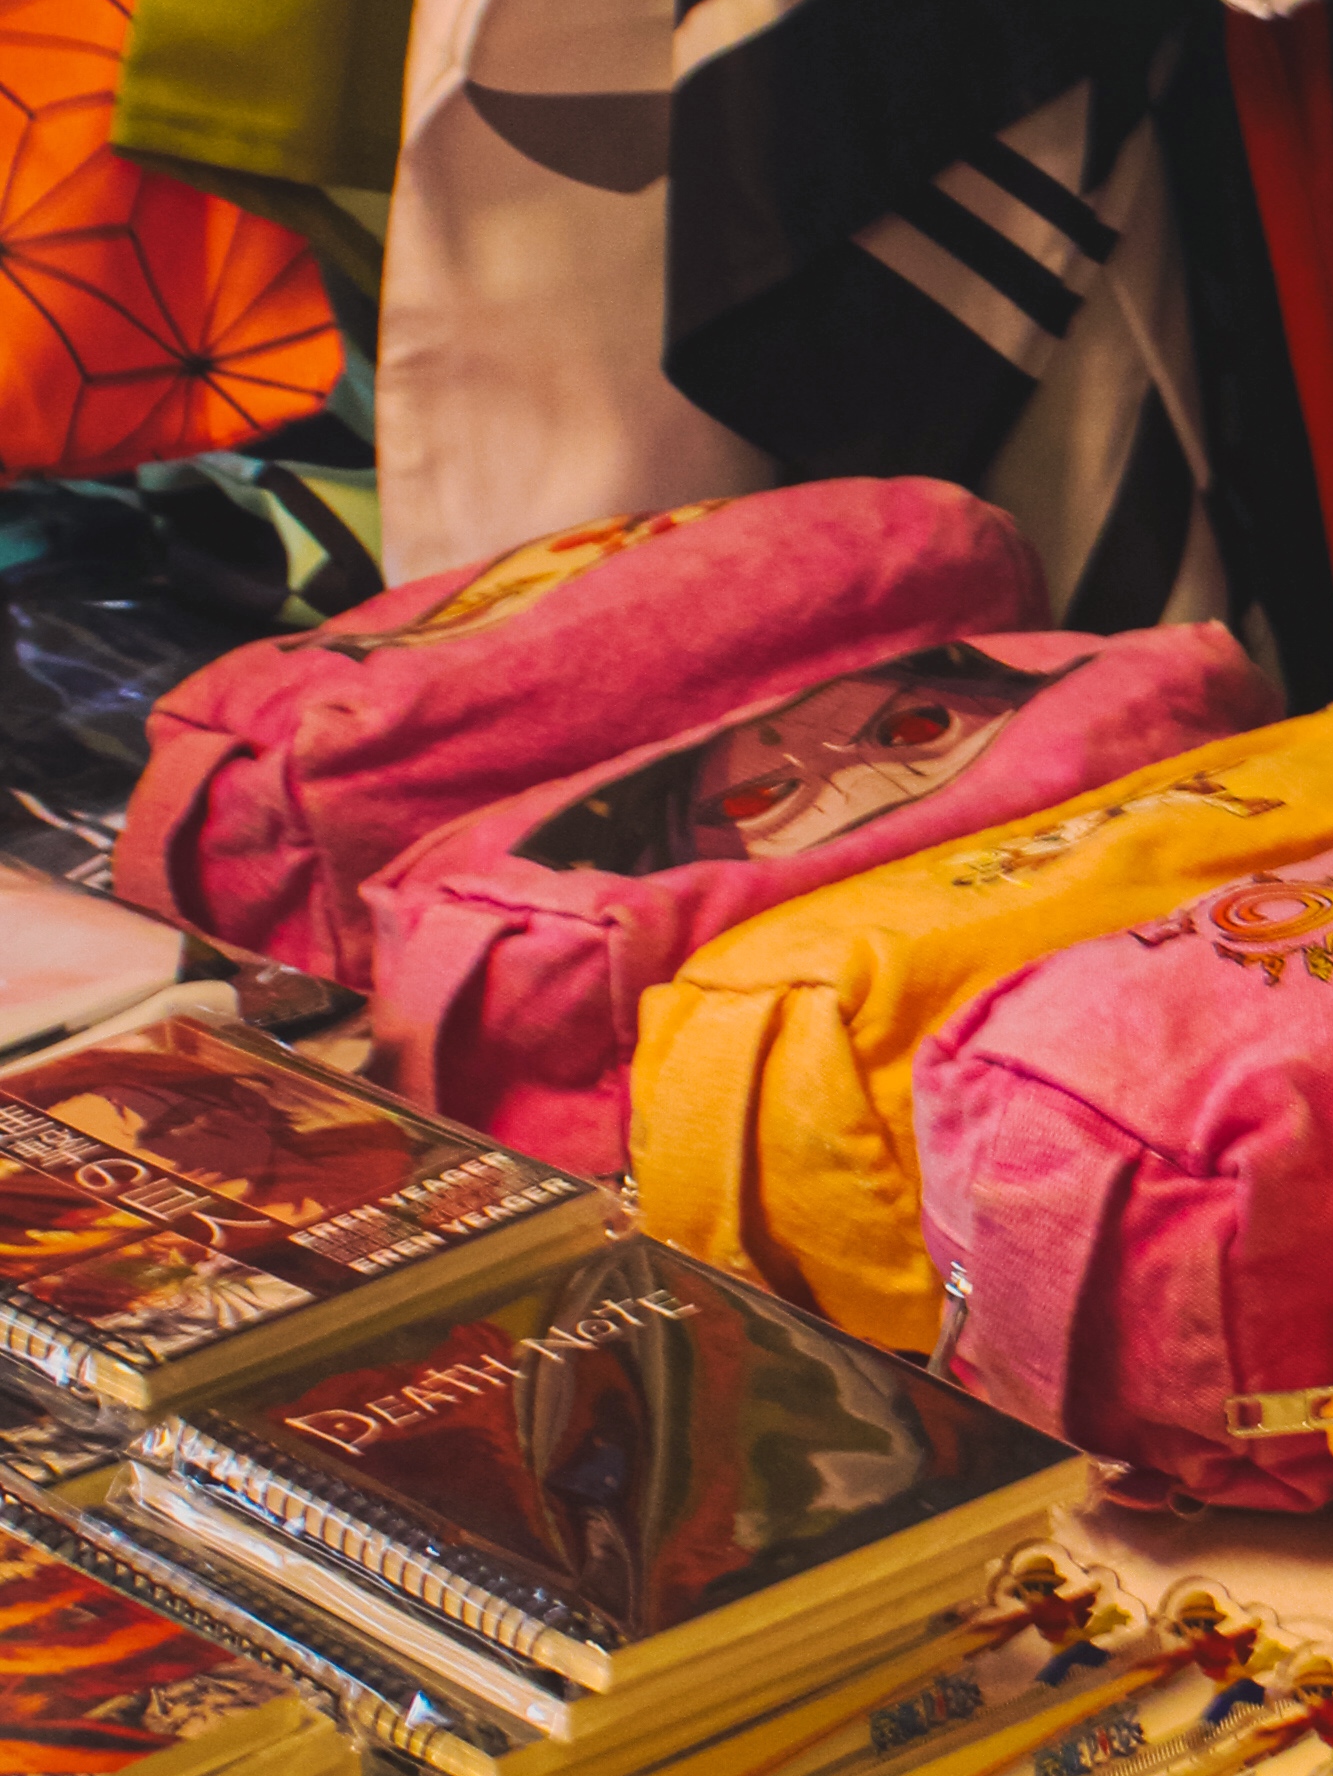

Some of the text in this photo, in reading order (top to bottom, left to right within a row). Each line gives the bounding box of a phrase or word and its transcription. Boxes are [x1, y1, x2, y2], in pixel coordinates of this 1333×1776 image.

[288, 1151, 516, 1248] EREN YEAGER
[347, 1177, 578, 1274] EREN YEAGER
[284, 1353, 528, 1456] DEATH
